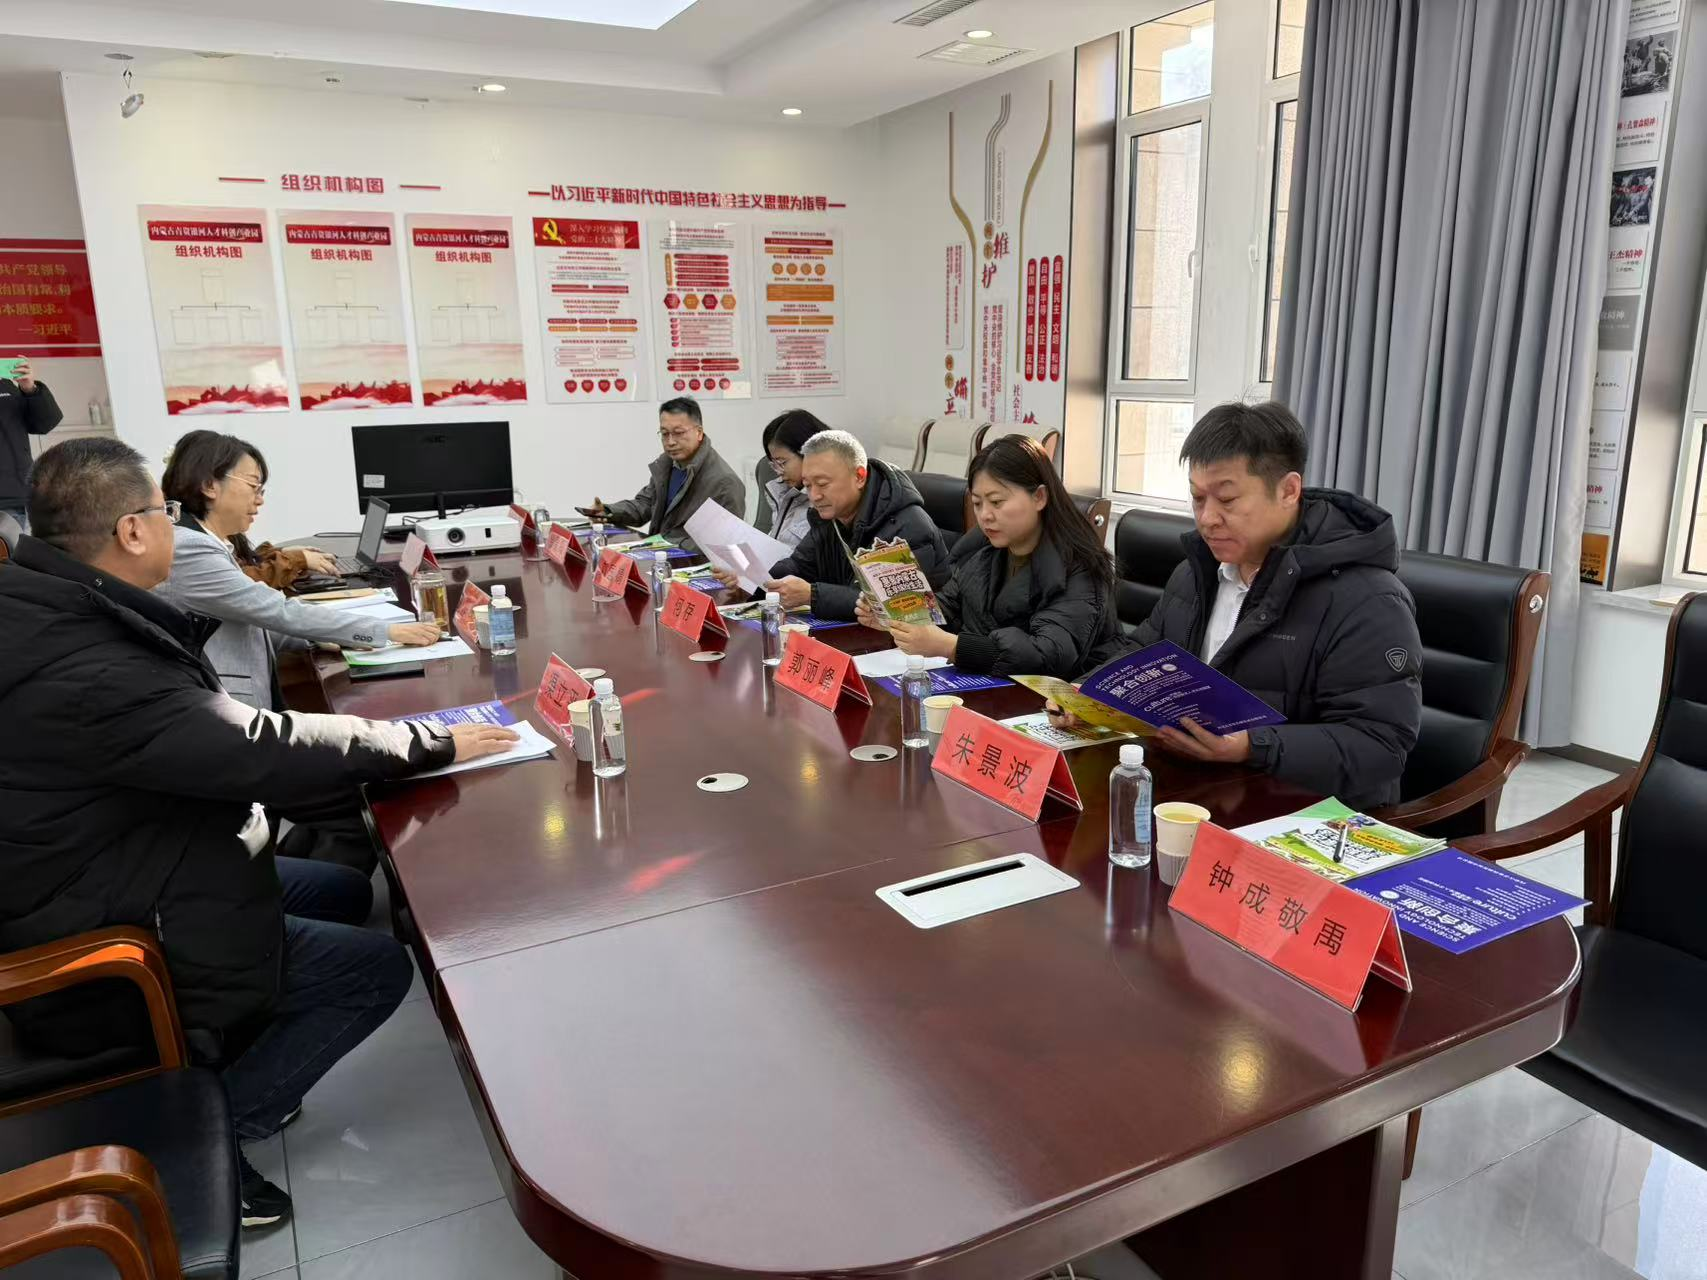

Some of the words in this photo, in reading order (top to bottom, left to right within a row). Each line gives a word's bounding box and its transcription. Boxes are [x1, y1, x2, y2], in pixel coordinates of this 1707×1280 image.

[281, 173, 385, 195] 组织机构图
[551, 184, 828, 211] 以习近平新时代中国特色社会主义思想为指导
[174, 244, 243, 258] 组织机构图
[310, 248, 373, 261] 组织机构图
[435, 250, 492, 263] 组织机构图
[787, 650, 836, 691] 郭丽峰
[1101, 667, 1140, 692] TECHNOLOGY
[1140, 653, 1179, 671] INNOVATION
[1120, 663, 1134, 674] AND
[951, 732, 1033, 796] 朱景波
[1207, 859, 1348, 957] 钟成敬禹
[1399, 897, 1482, 935] 聚合创新
[1399, 912, 1421, 926] AND
[1404, 909, 1466, 940] TECHNOLOGY
[1423, 923, 1461, 943] SCIENCE
